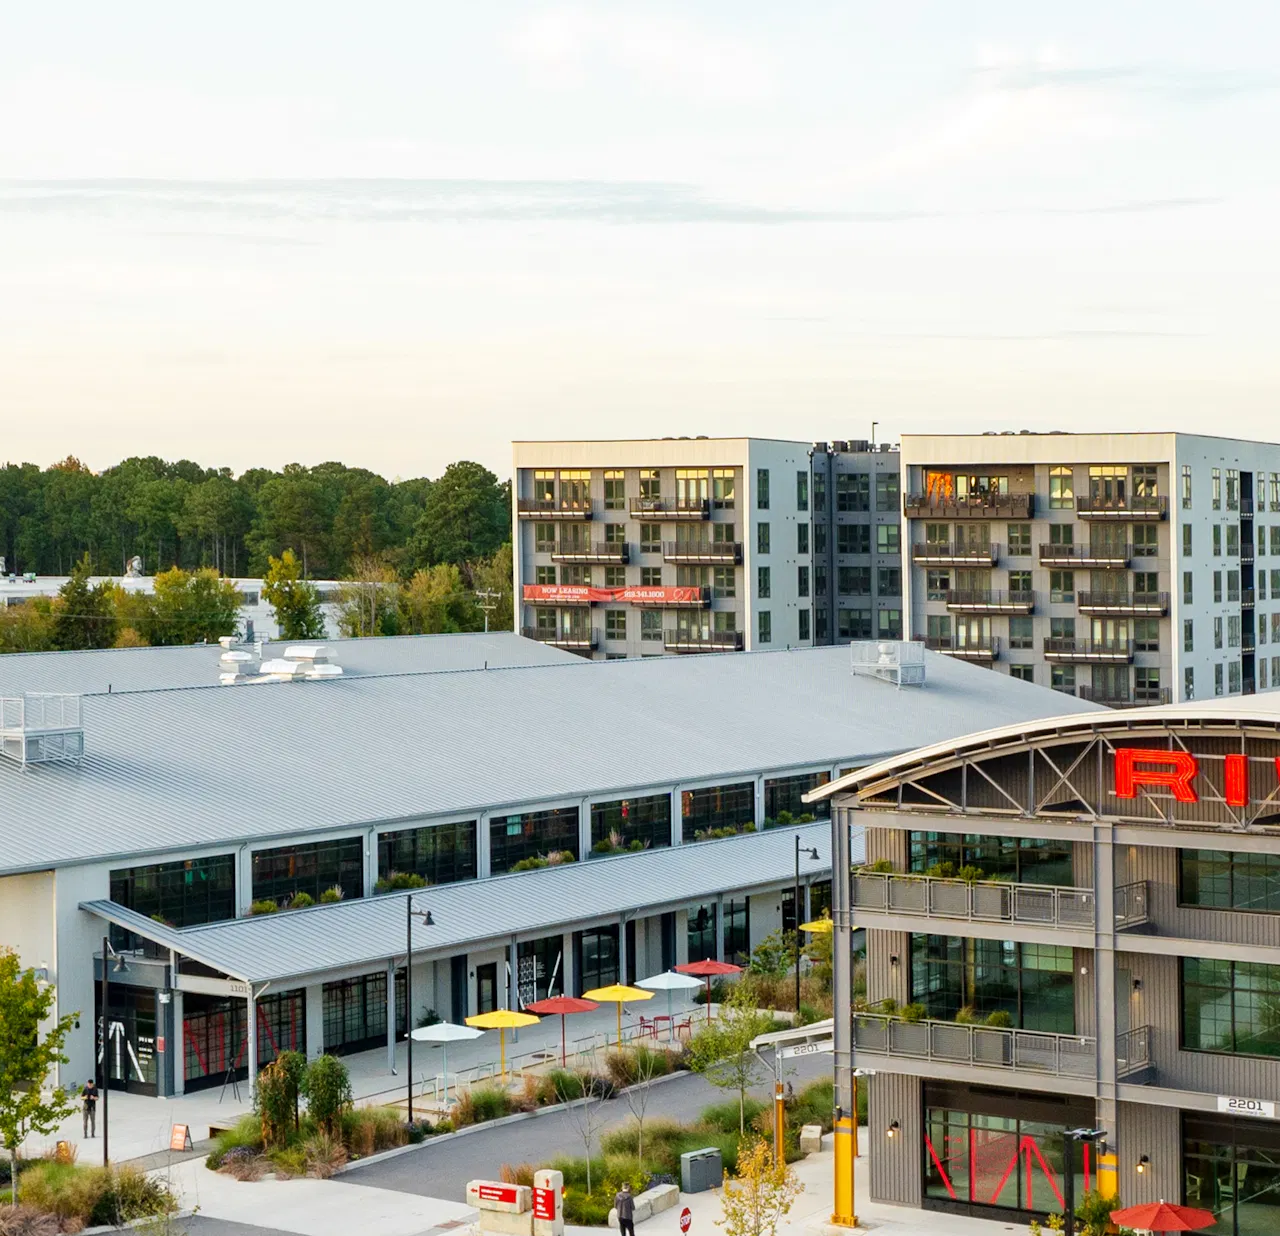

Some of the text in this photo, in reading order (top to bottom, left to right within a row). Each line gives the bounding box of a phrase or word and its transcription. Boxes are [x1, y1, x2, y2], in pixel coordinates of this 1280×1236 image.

[559, 587, 588, 595] LEASING
[793, 1044, 819, 1055] 2201
[1228, 1098, 1263, 1111] 2201
